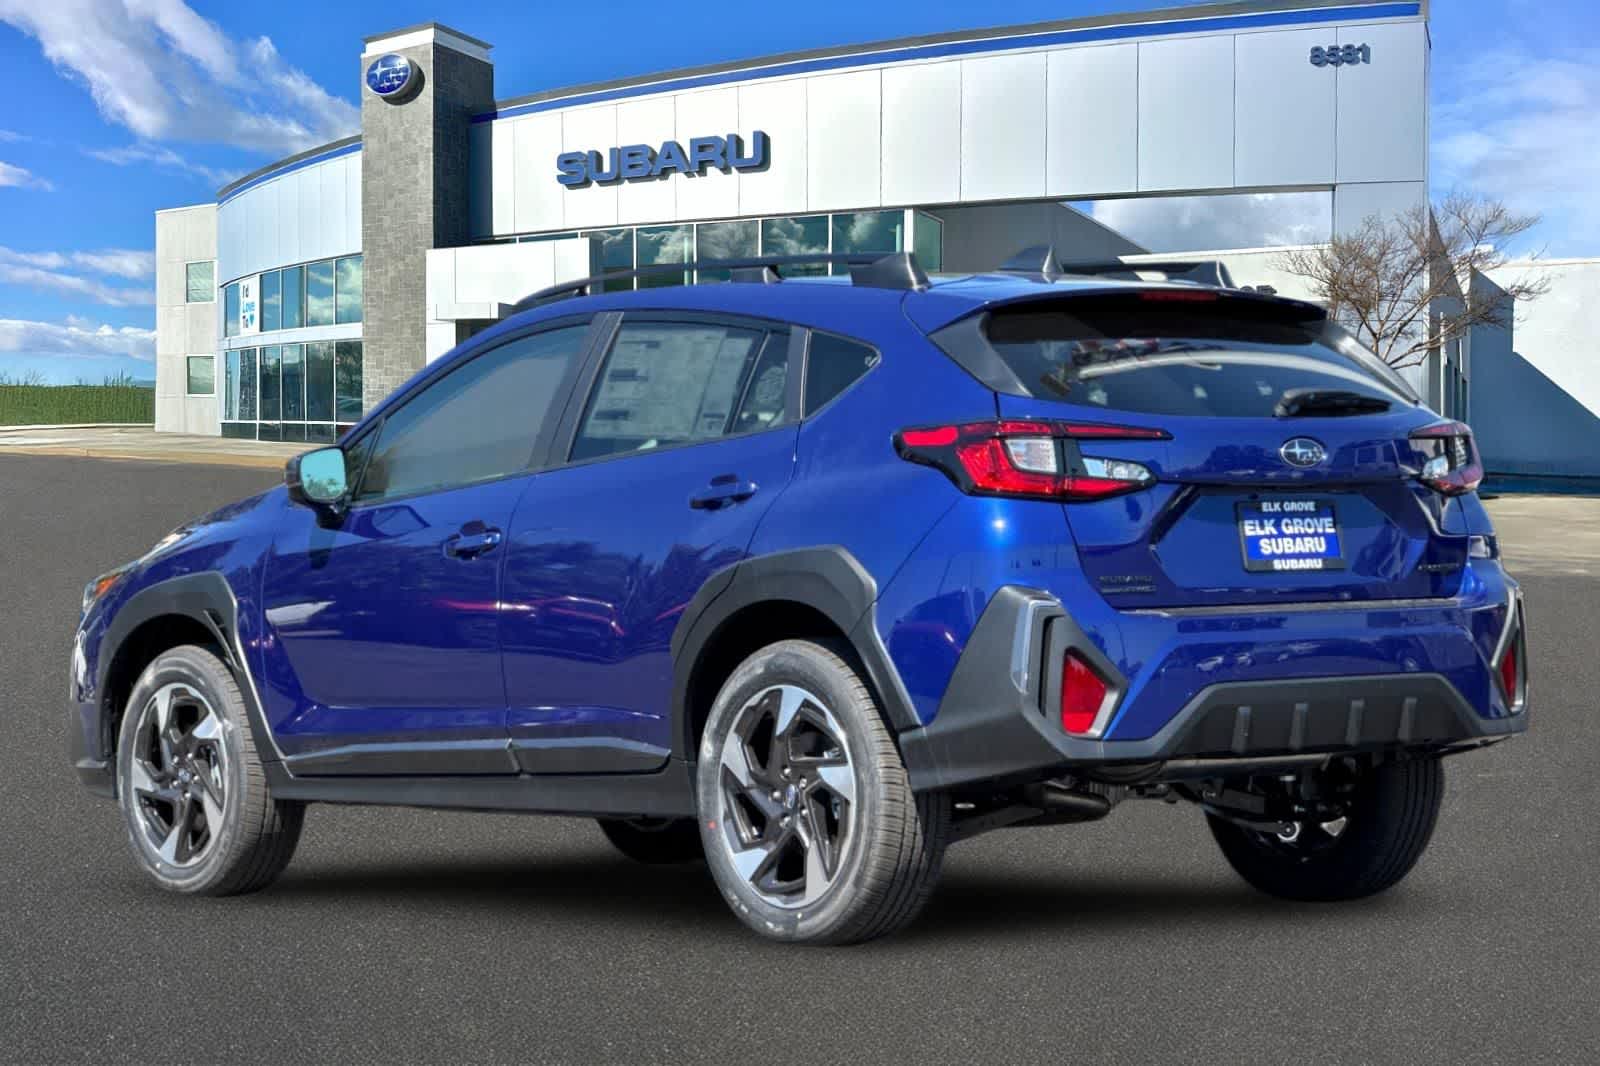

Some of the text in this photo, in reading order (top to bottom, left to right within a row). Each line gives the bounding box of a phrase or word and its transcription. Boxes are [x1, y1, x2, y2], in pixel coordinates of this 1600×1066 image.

[556, 130, 771, 190] SUBARU
[1261, 501, 1316, 512] ELK GROVE
[1244, 517, 1336, 536] ELK GROVE
[1259, 536, 1327, 555] SUBARU
[1273, 558, 1323, 571] SUBARU
